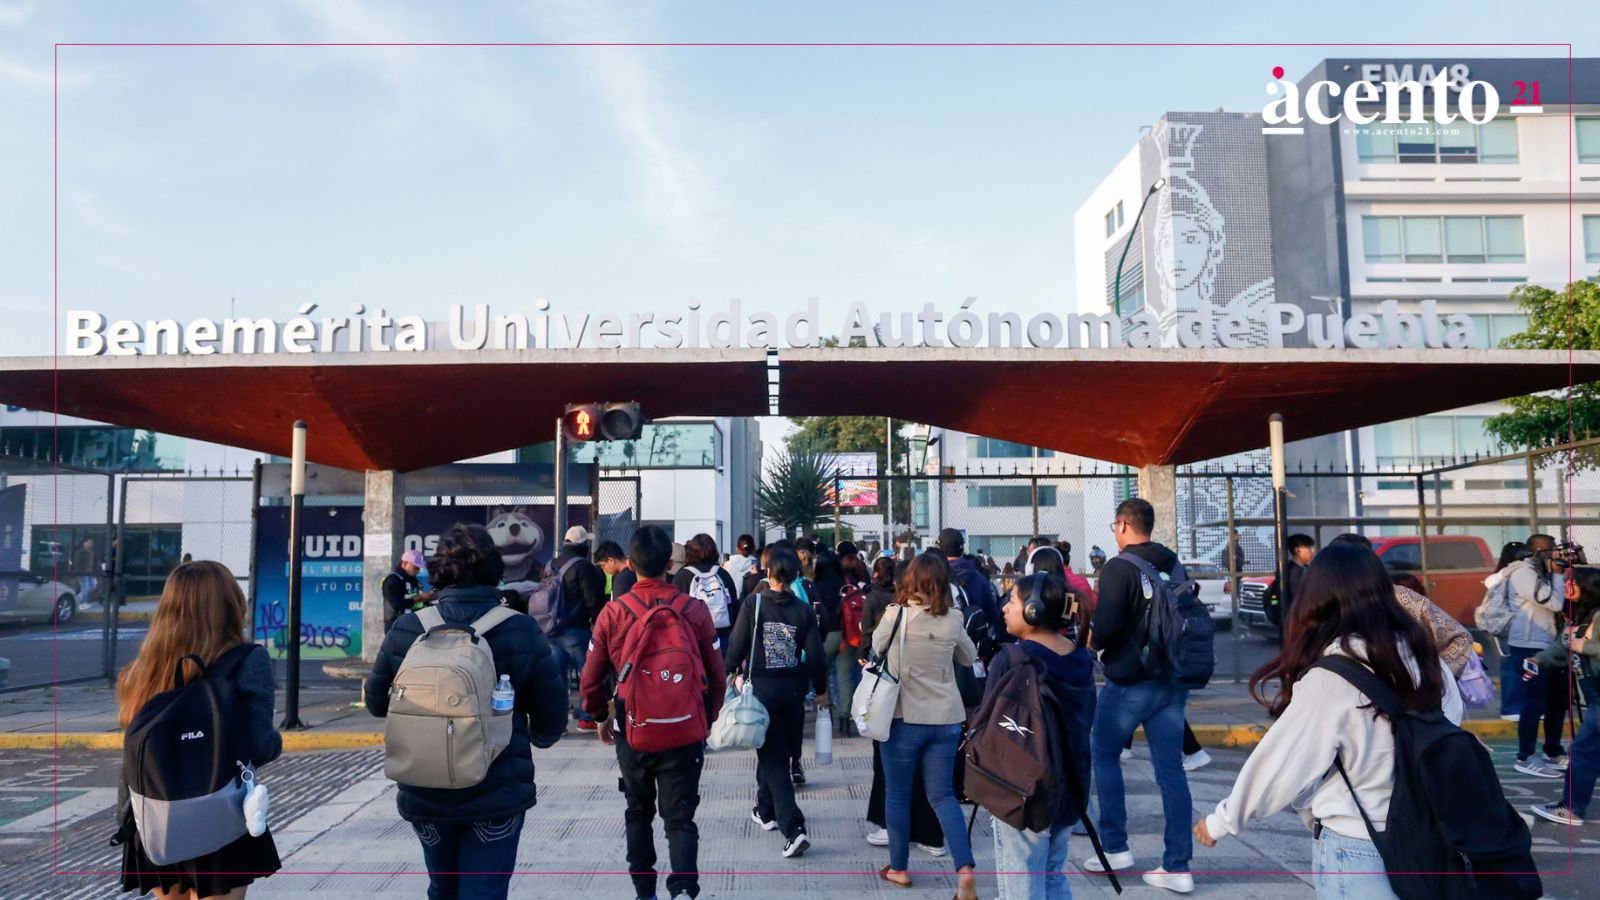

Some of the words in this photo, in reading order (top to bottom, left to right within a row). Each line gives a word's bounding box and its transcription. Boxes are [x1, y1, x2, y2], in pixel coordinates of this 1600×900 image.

[66, 303, 428, 356] Benemérita
[448, 297, 820, 351] Universidad
[837, 296, 1162, 349] Autónoma
[1177, 298, 1252, 350] de
[1268, 298, 1477, 351] Puebla
[181, 730, 205, 741] FILA
